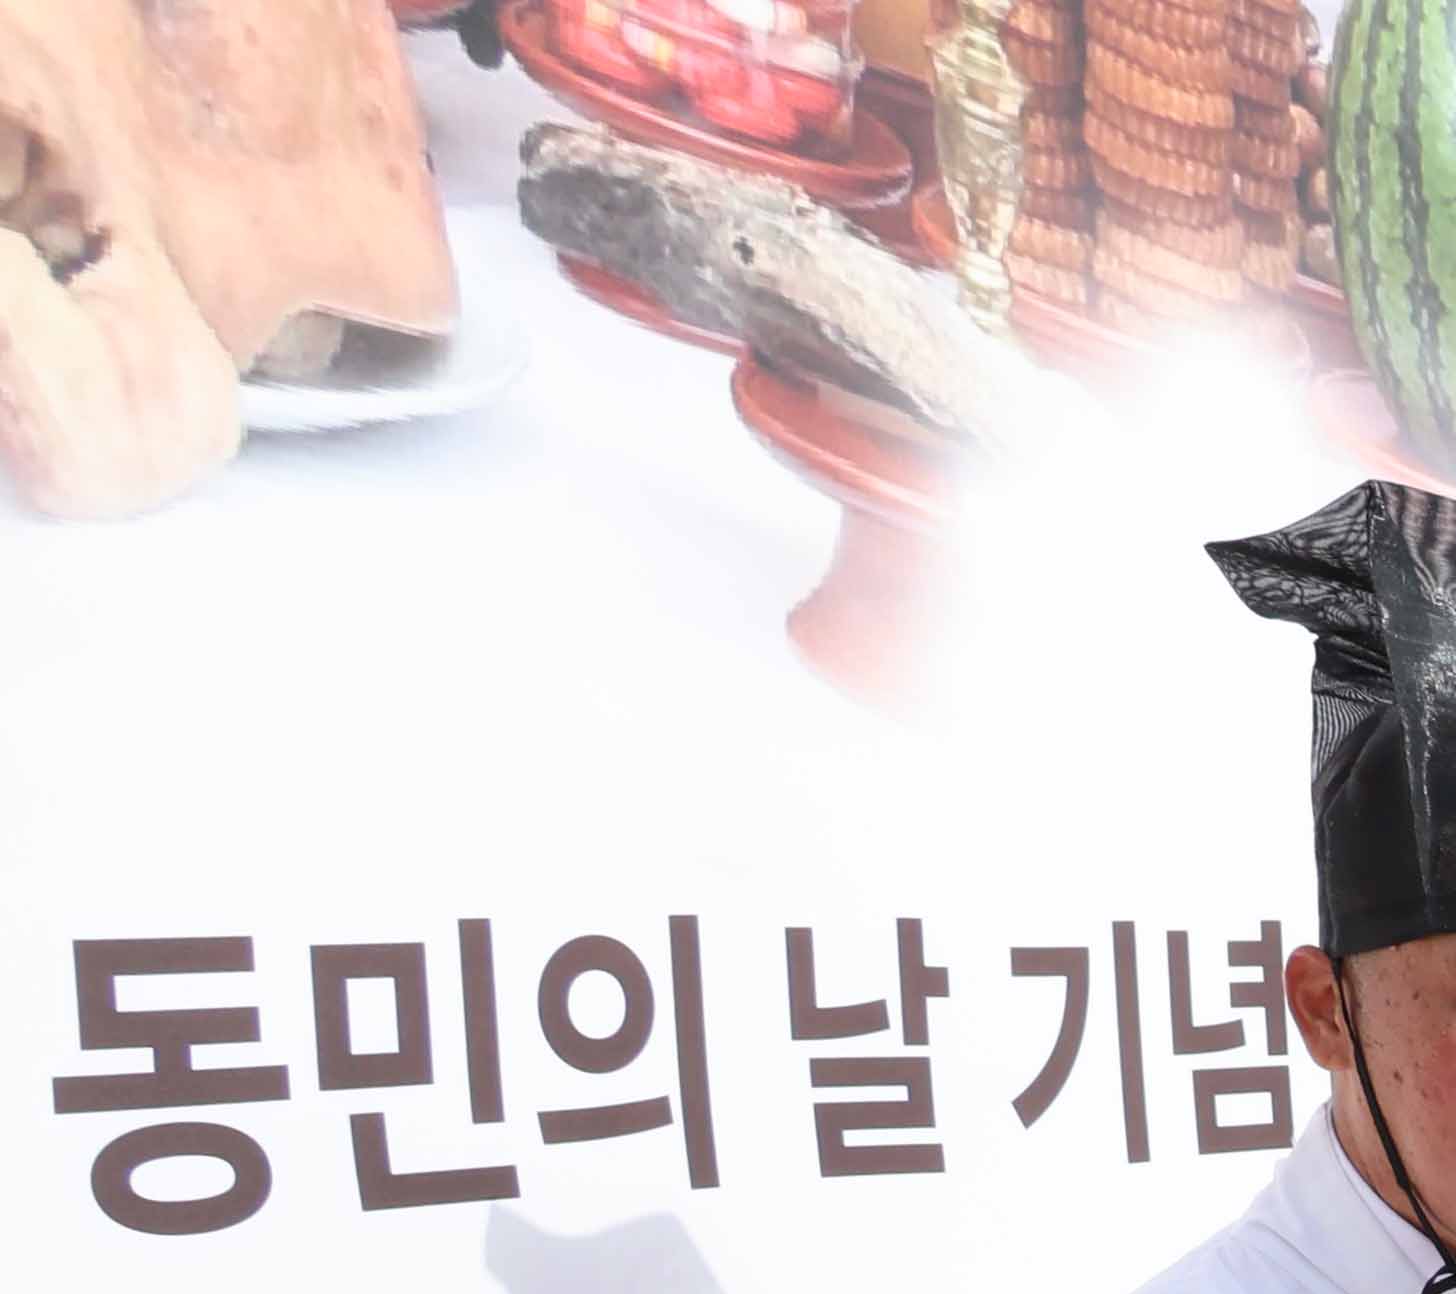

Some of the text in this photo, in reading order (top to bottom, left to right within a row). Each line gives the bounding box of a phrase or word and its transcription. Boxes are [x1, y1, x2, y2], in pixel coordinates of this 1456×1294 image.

[51, 913, 1295, 1236] 동민의 날 기념
